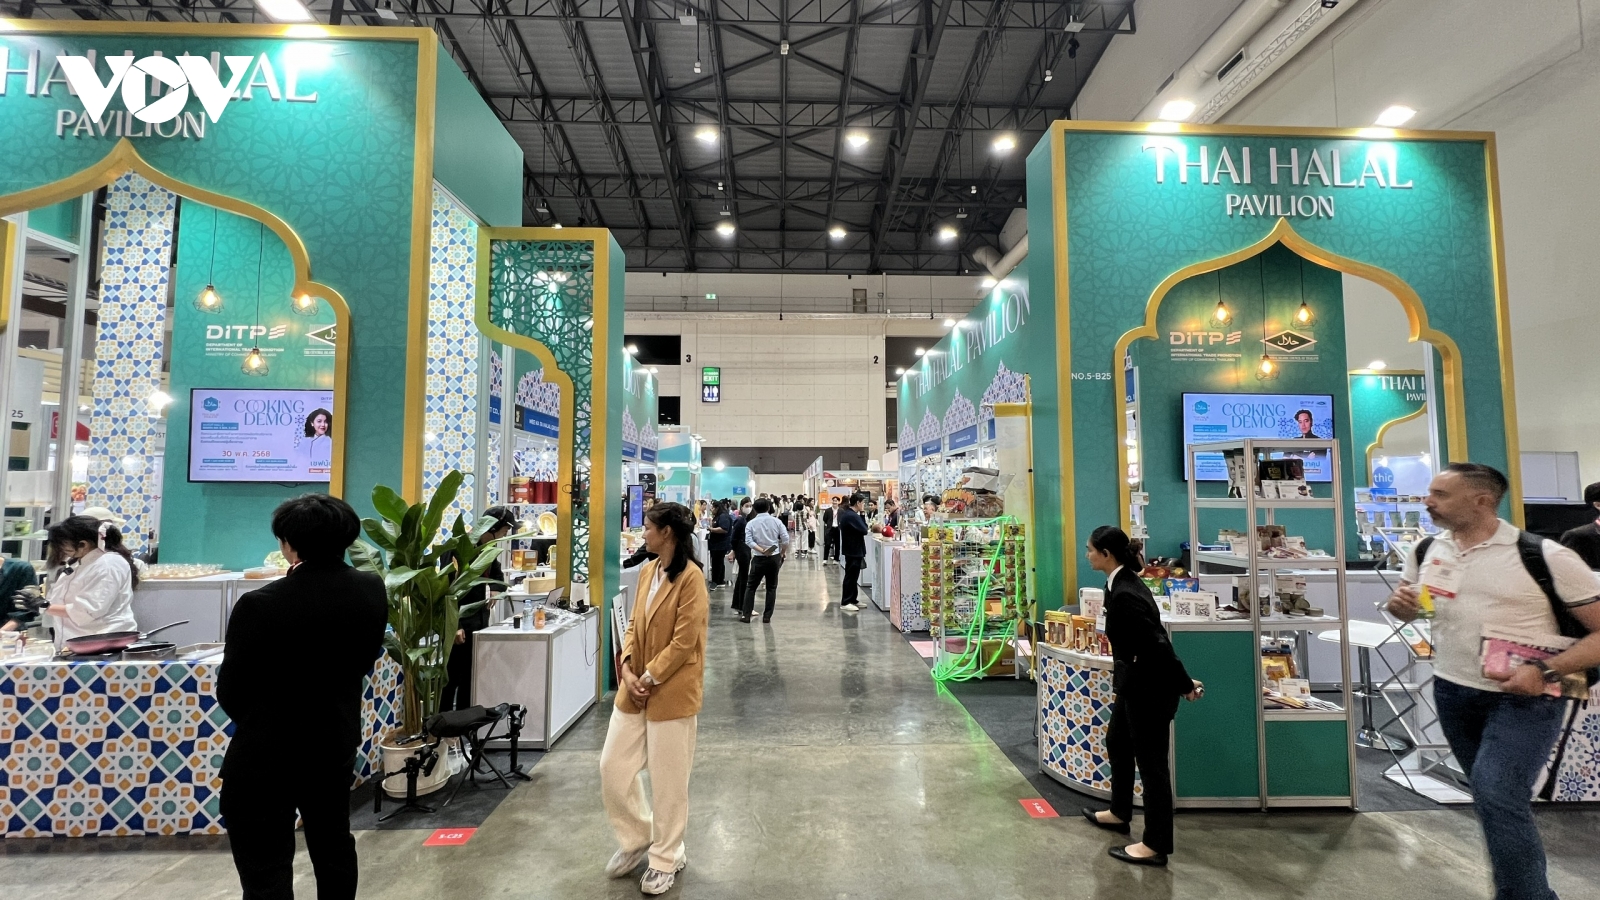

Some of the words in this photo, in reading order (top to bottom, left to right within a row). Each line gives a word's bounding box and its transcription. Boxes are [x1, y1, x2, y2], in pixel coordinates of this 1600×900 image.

[1142, 144, 1252, 185] THAI
[1269, 147, 1414, 189] HALAL
[1226, 193, 1335, 218] PAVILION
[914, 365, 932, 400] THAI
[933, 341, 963, 388] HALAL
[966, 287, 1031, 364] PAVILION
[685, 354, 692, 363] 3
[873, 355, 879, 364] 2
[1071, 372, 1112, 380] NO.5-B25
[1377, 376, 1416, 391] THAI
[234, 399, 305, 414] COOKING
[1222, 402, 1286, 417] COOKING
[11, 409, 24, 419] 25
[244, 412, 293, 426] DEMO
[1231, 415, 1276, 428] DEMO
[1373, 472, 1393, 483] thic
